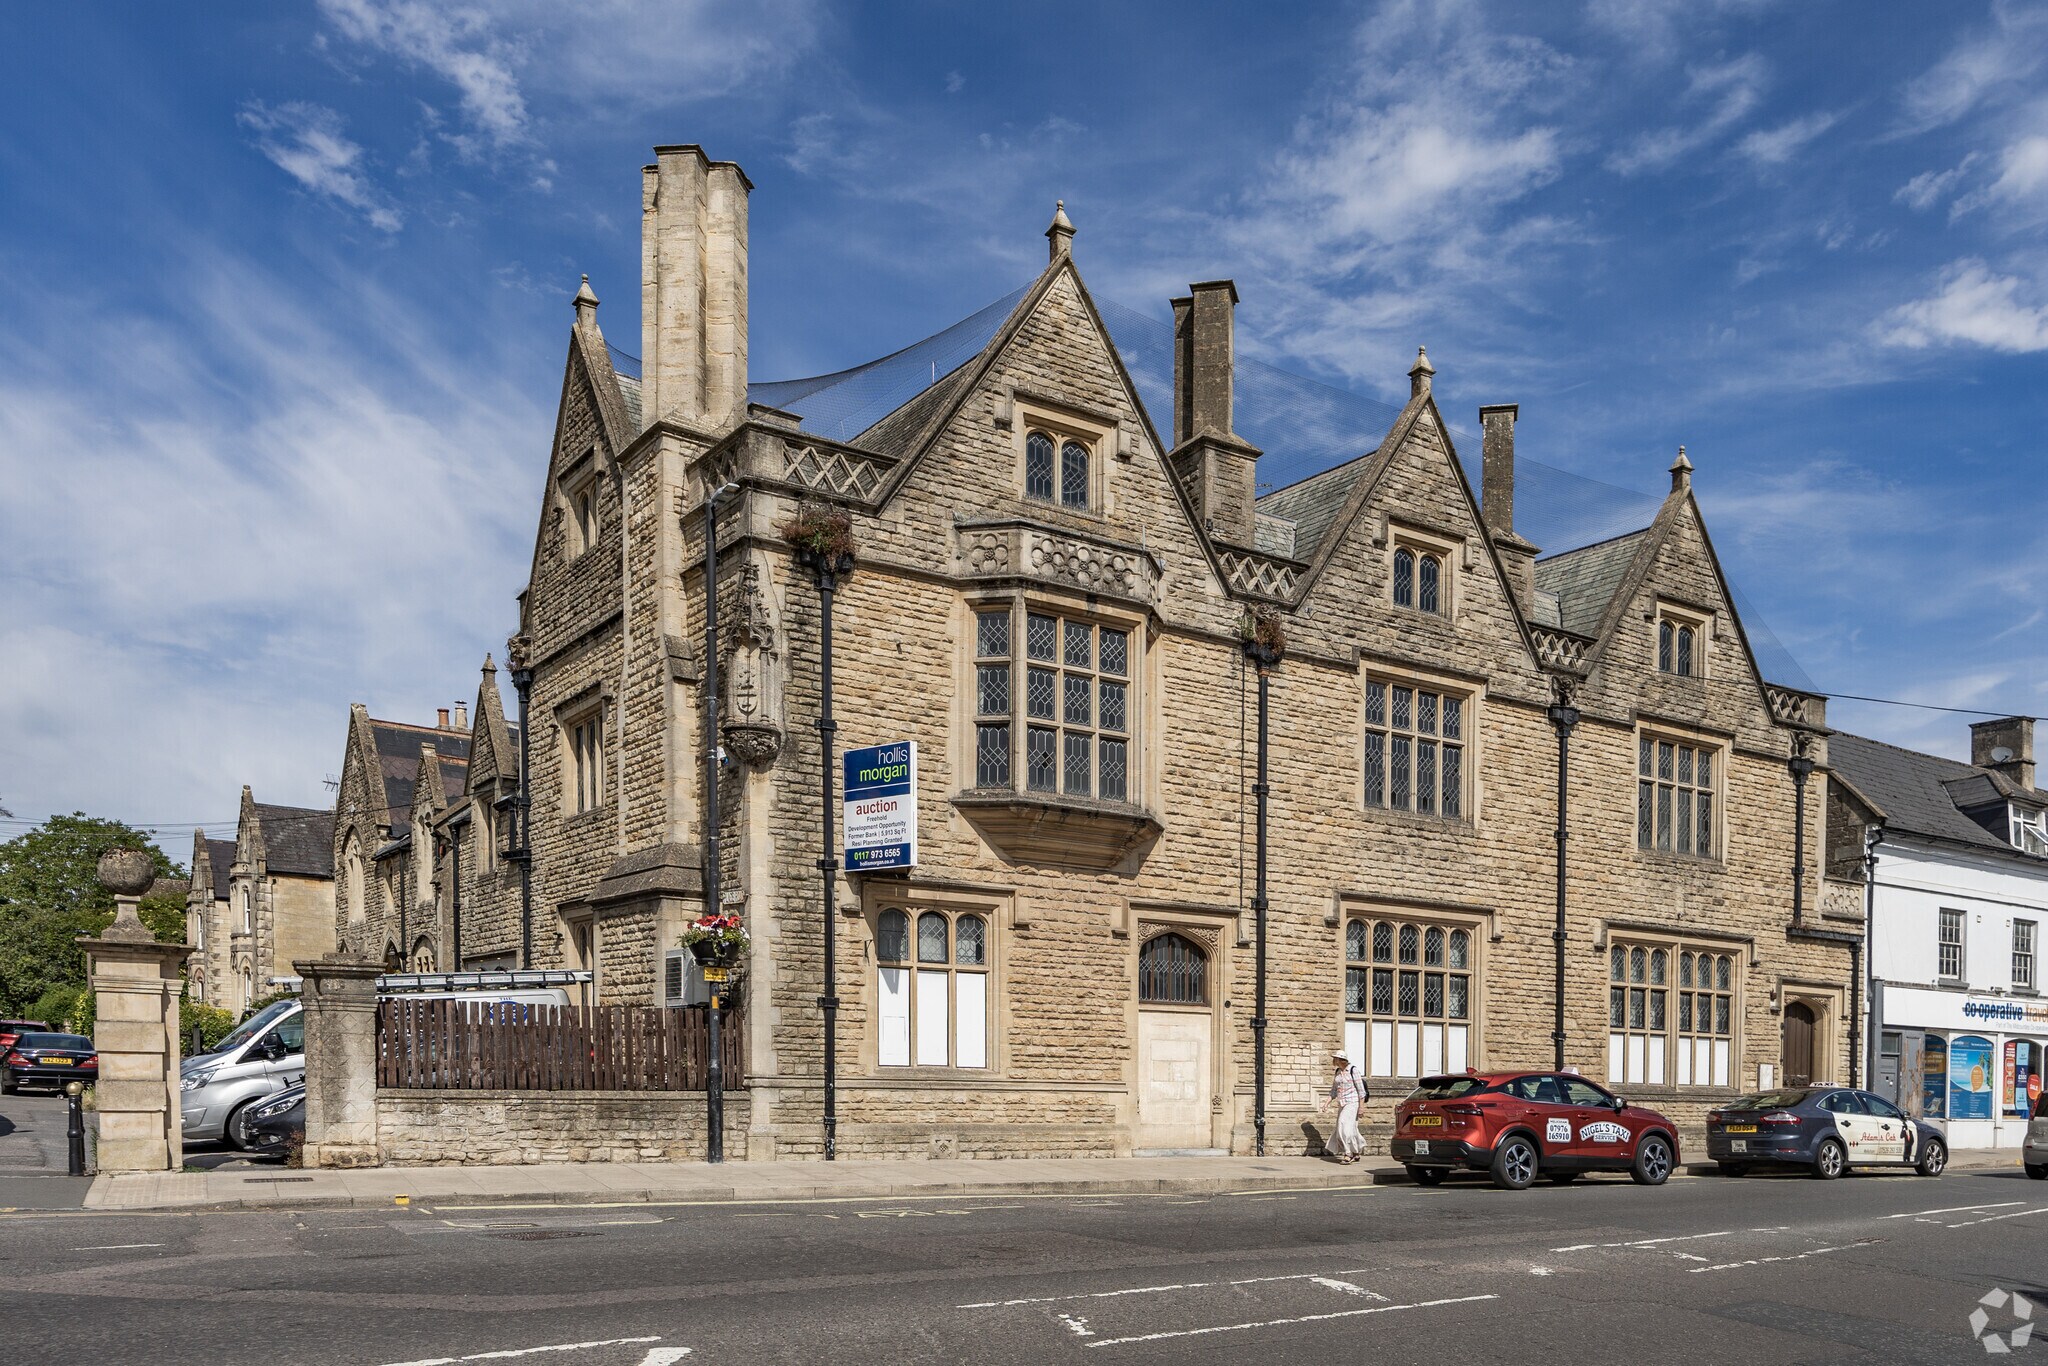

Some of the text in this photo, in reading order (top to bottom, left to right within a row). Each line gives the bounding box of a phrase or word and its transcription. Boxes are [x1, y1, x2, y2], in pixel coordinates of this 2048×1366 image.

[878, 747, 908, 765] hollis
[860, 764, 908, 782] morgan
[855, 800, 898, 816] auction
[848, 820, 907, 832] Development Opportunity
[863, 838, 884, 846] Planning
[884, 836, 903, 844] Granted
[854, 848, 901, 861] 0117 973 6565
[1965, 1002, 2023, 1022] co-operative
[1550, 1125, 1568, 1133] 07976
[1581, 1123, 1630, 1140] NIGEL'S TAXI
